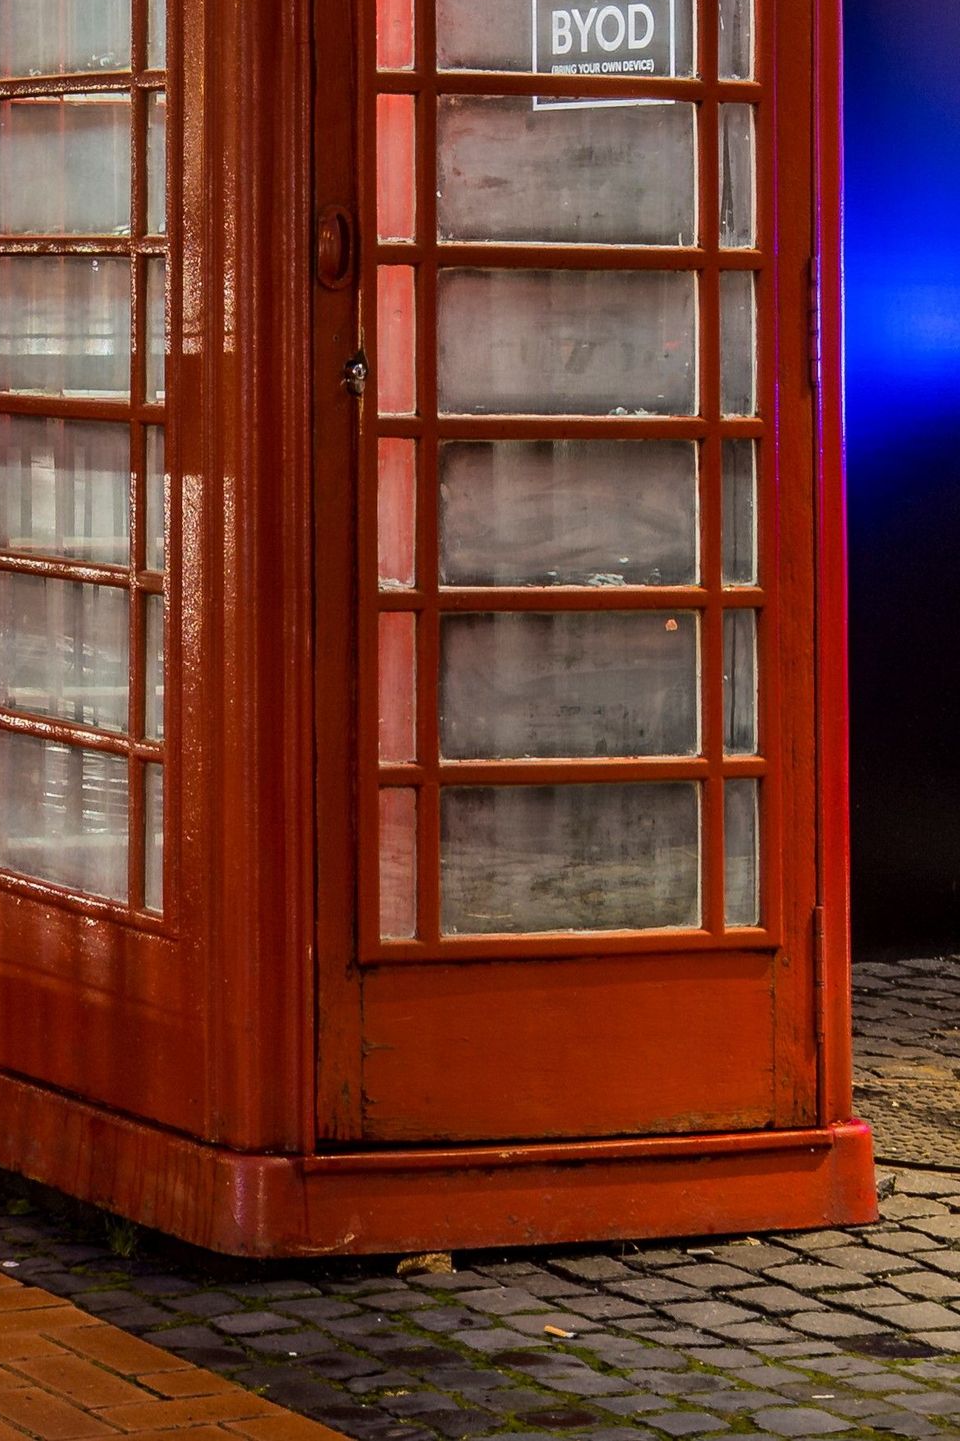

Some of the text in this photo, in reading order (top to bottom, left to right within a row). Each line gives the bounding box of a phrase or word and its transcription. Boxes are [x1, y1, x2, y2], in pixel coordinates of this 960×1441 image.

[551, 3, 655, 56] BYOD
[551, 58, 655, 75] (BRING YOUR OWN DEVICE)
